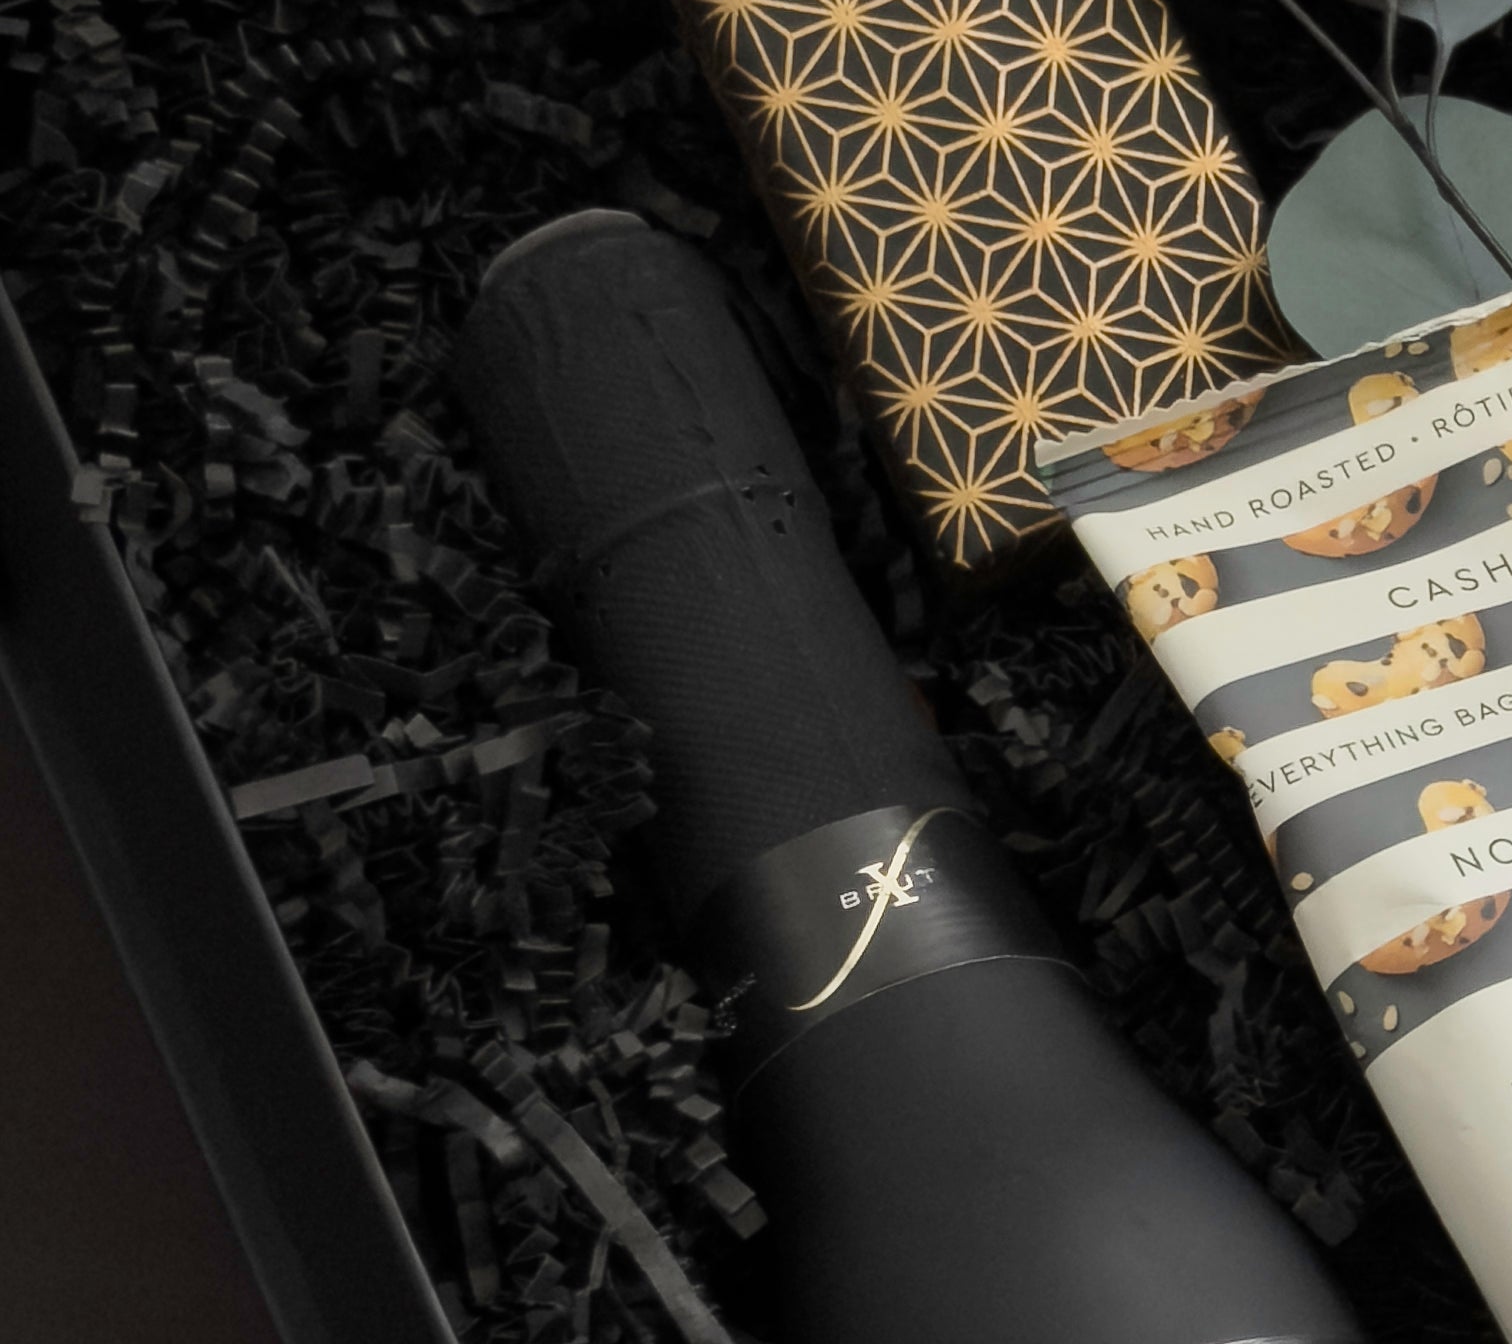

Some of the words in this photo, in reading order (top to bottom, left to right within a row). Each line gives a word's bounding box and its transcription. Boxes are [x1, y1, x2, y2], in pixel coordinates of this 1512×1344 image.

[1146, 510, 1236, 542] HAND
[1250, 442, 1396, 520] ROASTED
[1249, 719, 1444, 808] EVERYTHING
